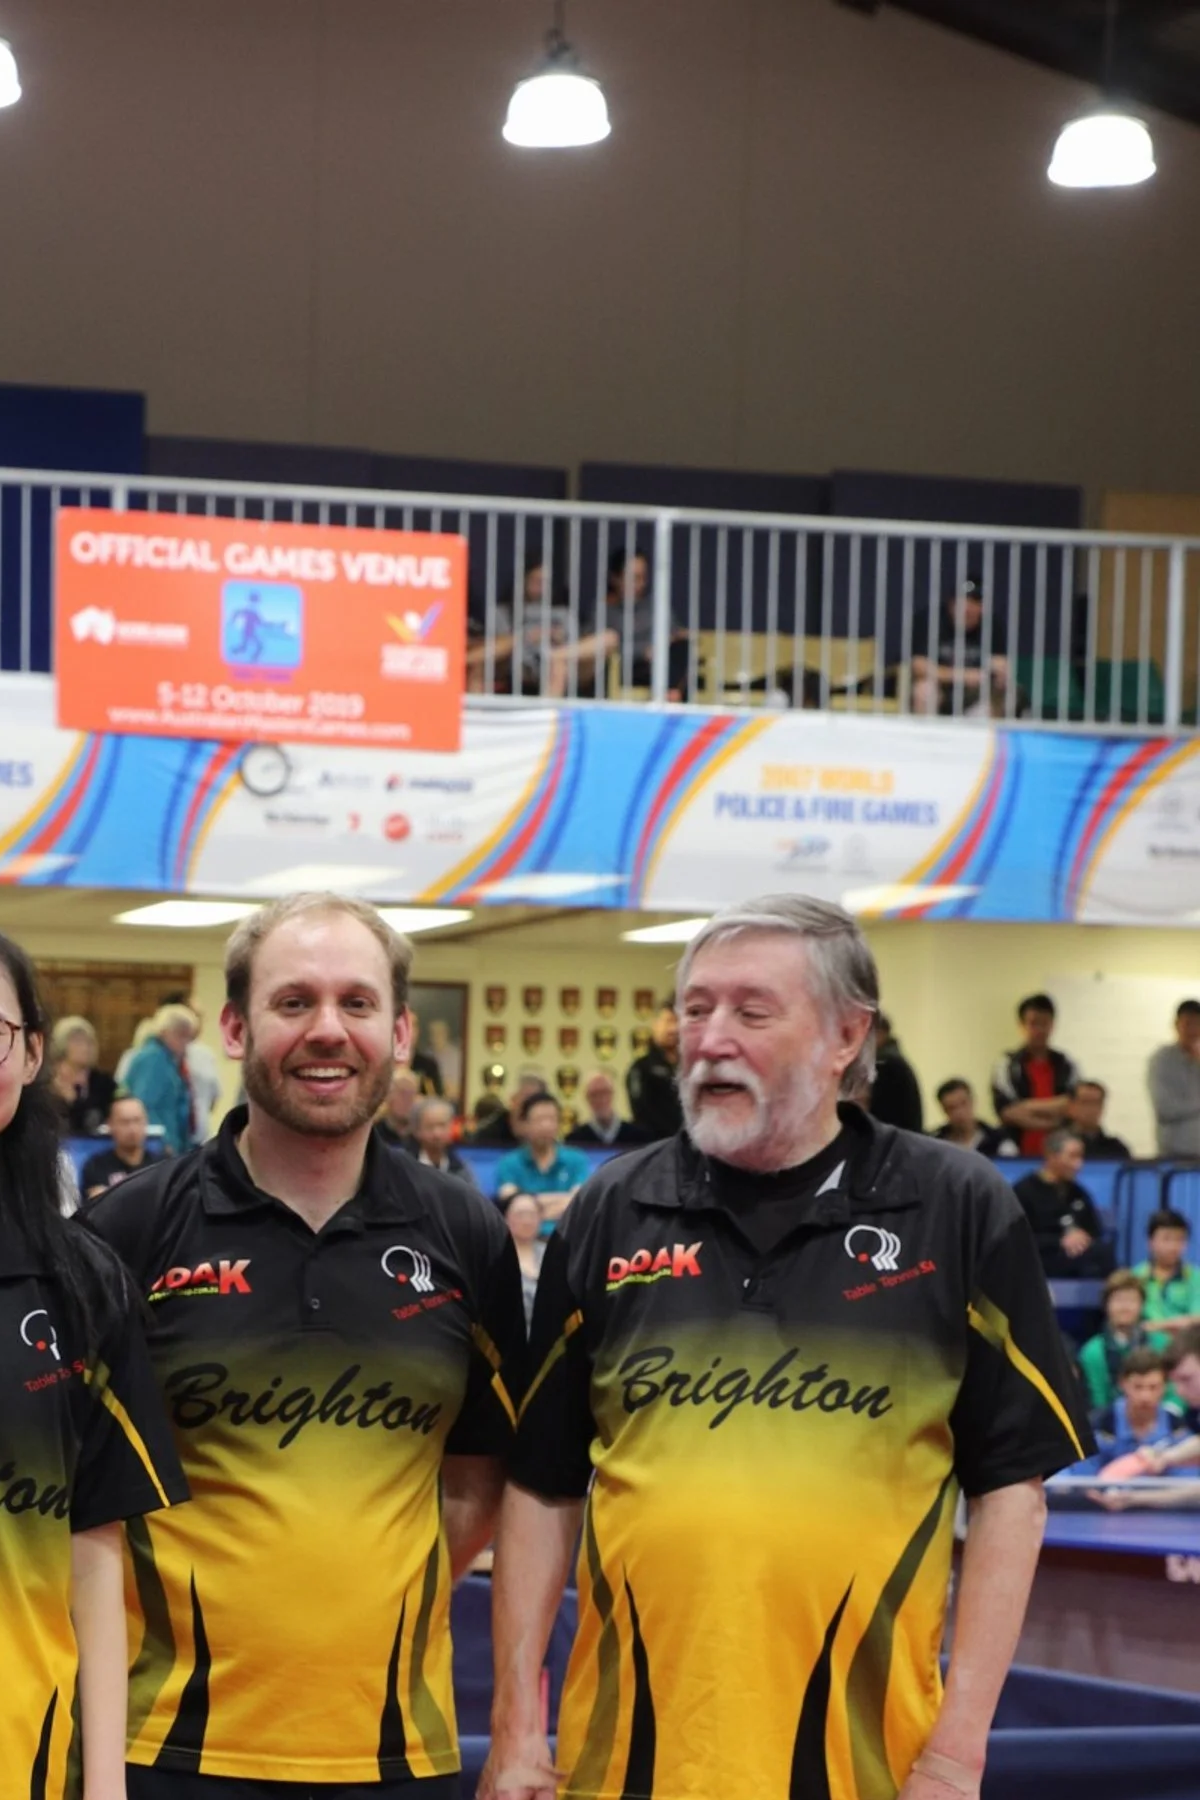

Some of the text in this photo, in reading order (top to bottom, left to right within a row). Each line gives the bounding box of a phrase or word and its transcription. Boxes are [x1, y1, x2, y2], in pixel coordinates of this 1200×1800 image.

[70, 531, 451, 588] OFFICIAL GAMES VENUE
[156, 681, 208, 709] 5-12
[211, 684, 304, 714] October
[819, 770, 894, 795] WORLD
[714, 793, 787, 819] POLICE
[812, 798, 855, 823] FIRE
[862, 800, 938, 826] GAMES
[607, 1241, 704, 1280] DOAK
[842, 1283, 877, 1301] Table
[24, 1373, 58, 1393] Table
[620, 1345, 893, 1430] Brighton
[165, 1362, 443, 1450] Brighton
